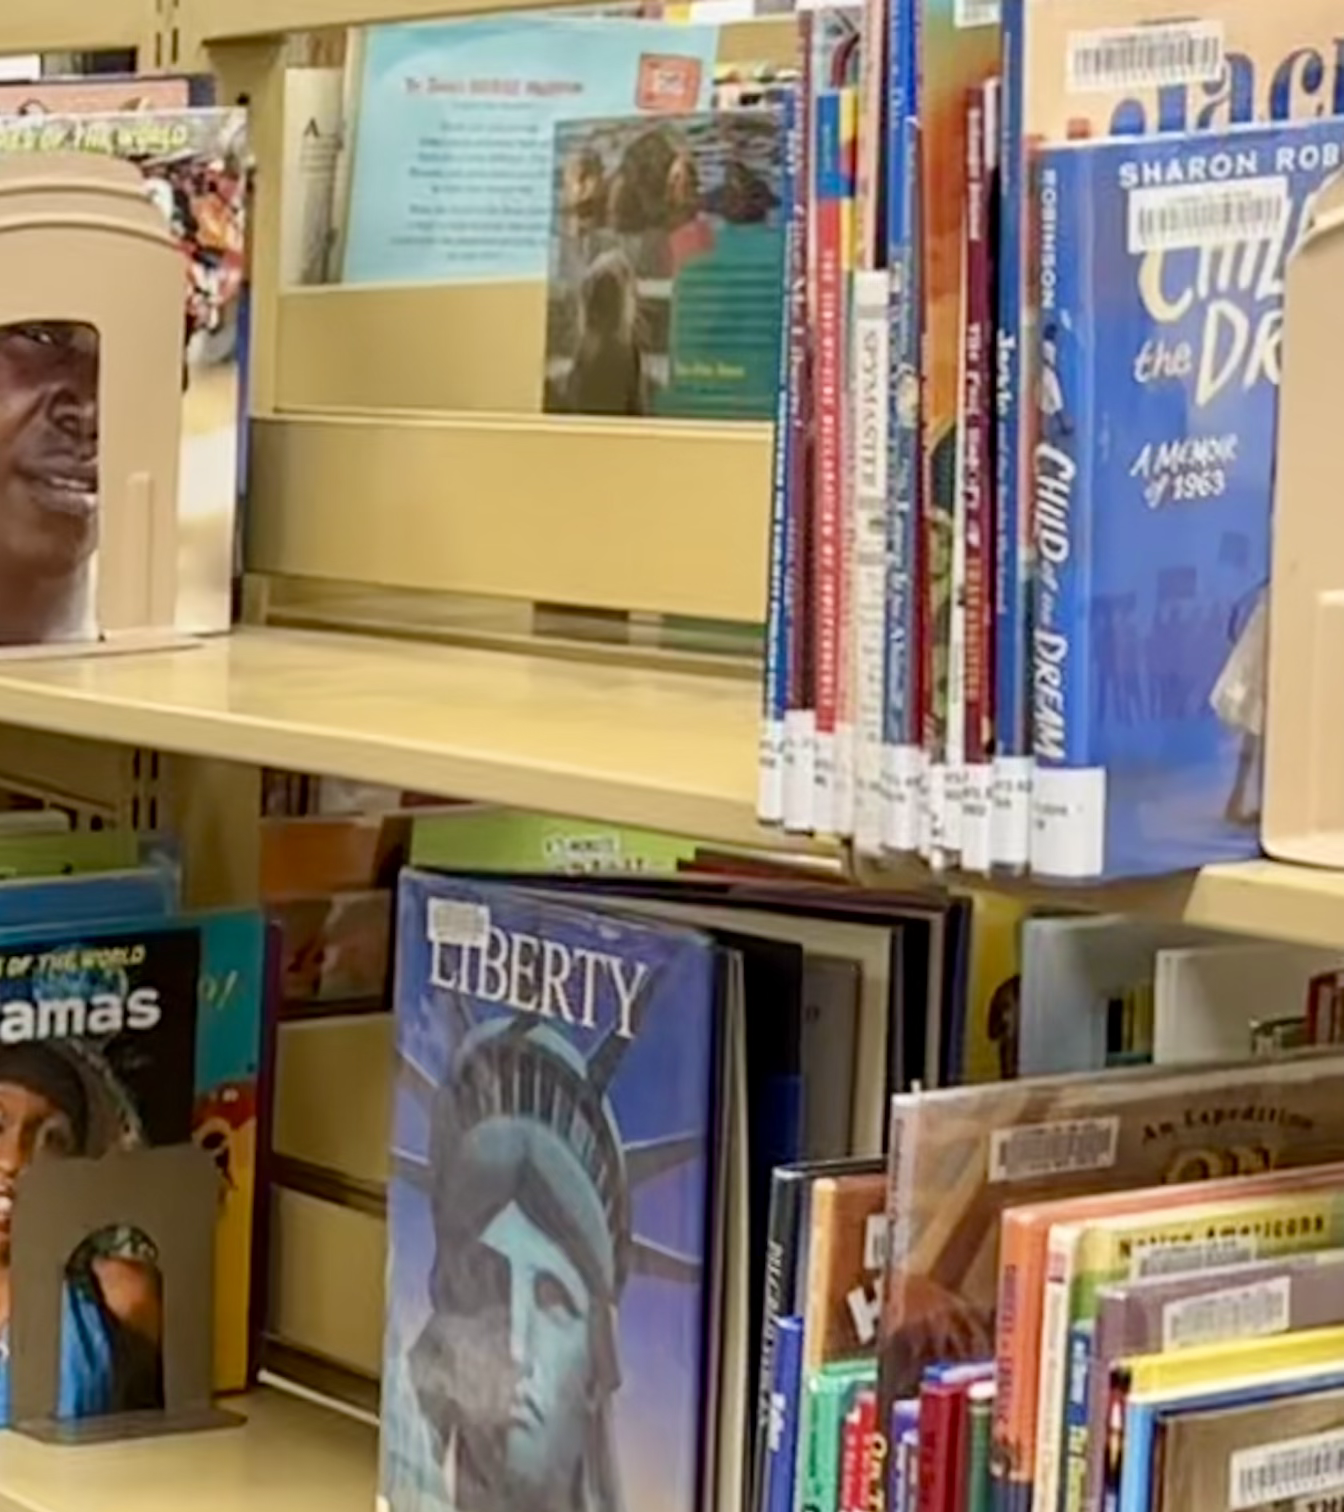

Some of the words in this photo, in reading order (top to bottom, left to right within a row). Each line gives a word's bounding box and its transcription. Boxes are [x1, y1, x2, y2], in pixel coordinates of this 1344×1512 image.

[1119, 153, 1258, 189] SHARON
[1040, 169, 1057, 309] ROBINSON
[1133, 340, 1192, 384] the
[862, 328, 880, 489] SPYMASTER
[1130, 444, 1151, 477] A
[1154, 433, 1240, 473] MEMOIR
[1034, 443, 1077, 564] CHILD
[1144, 474, 1171, 509] of
[1172, 468, 1226, 501] 1963
[1033, 628, 1069, 759] DREAM
[78, 945, 147, 969] WORLD
[428, 928, 650, 1041] LIBERTY
[868, 1432, 889, 1481] On
